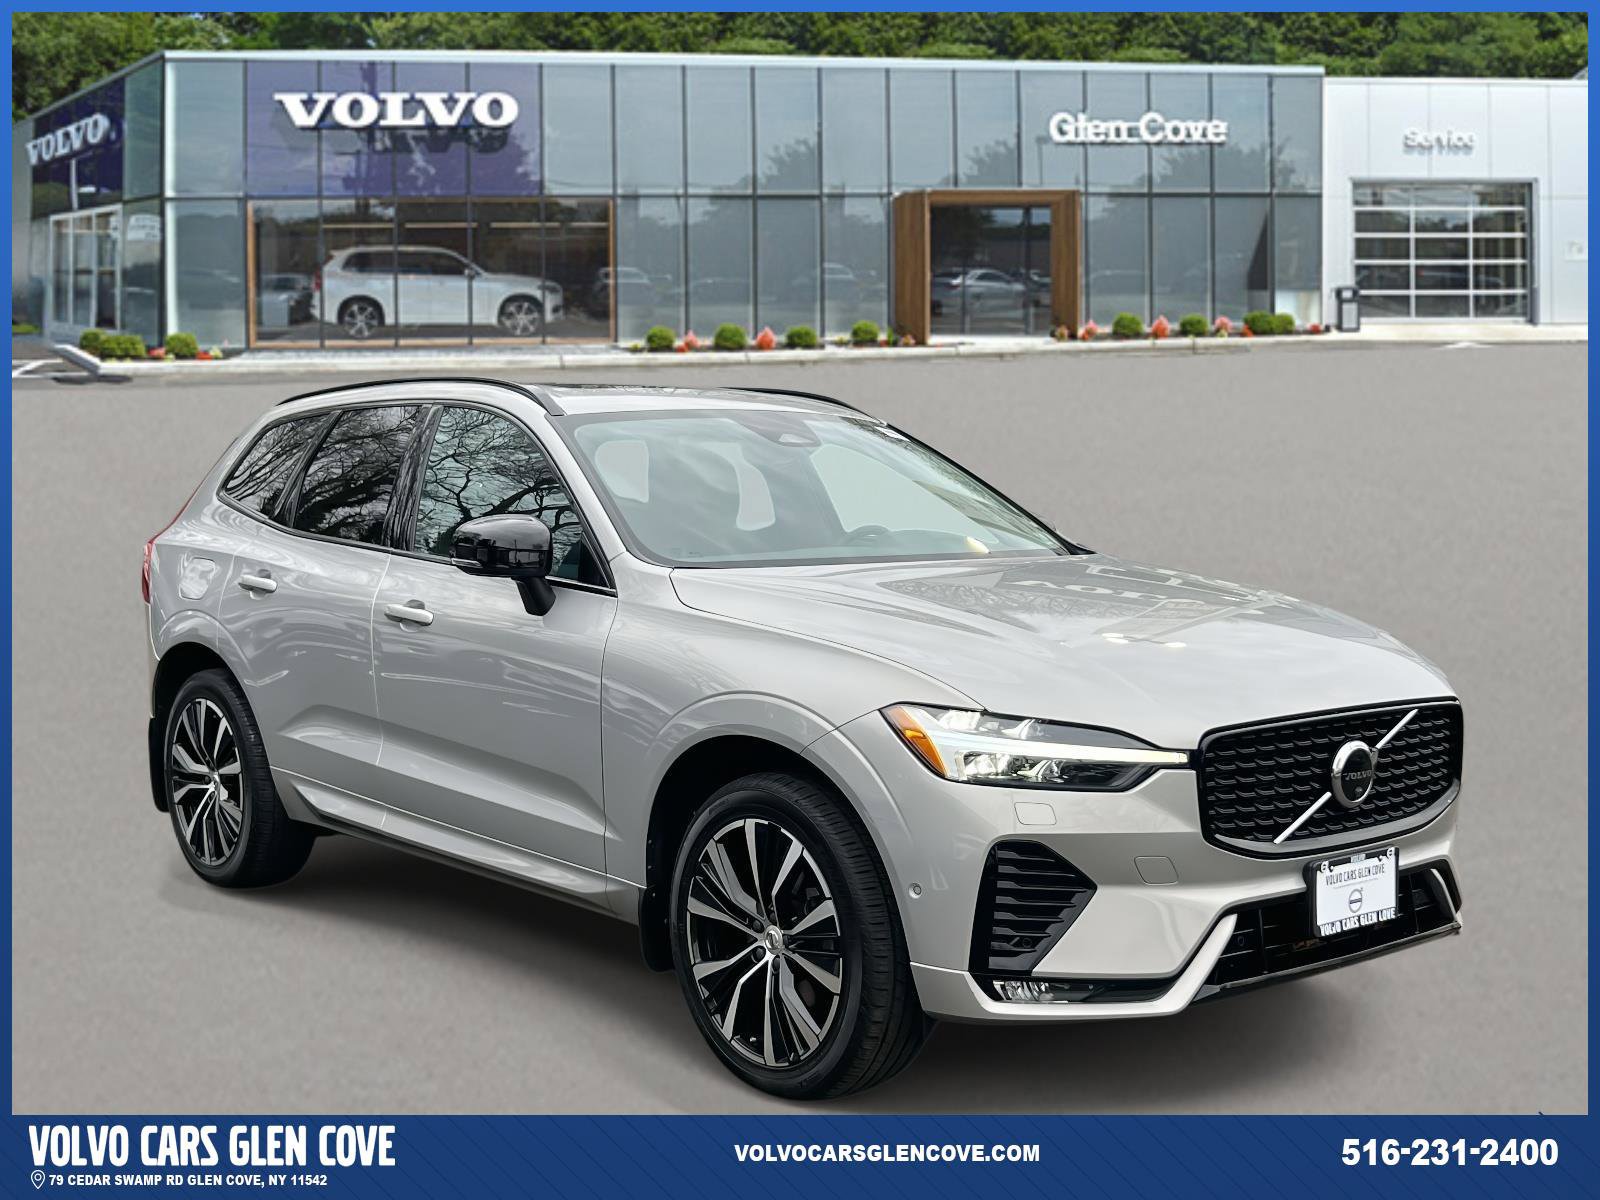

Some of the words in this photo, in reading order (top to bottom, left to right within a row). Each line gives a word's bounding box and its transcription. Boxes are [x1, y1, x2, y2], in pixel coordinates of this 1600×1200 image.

[273, 91, 519, 128] VOLVO
[26, 112, 111, 165] VOLVO
[1049, 112, 1130, 143] Glen
[1139, 111, 1228, 143] Cove
[1402, 128, 1476, 153] Service
[1326, 873, 1342, 886] VOLVO
[1343, 869, 1357, 882] CARS
[1358, 866, 1371, 879] GLEN
[1372, 864, 1385, 875] COVE
[1342, 917, 1360, 931] CARS
[1360, 911, 1378, 926] GLEN
